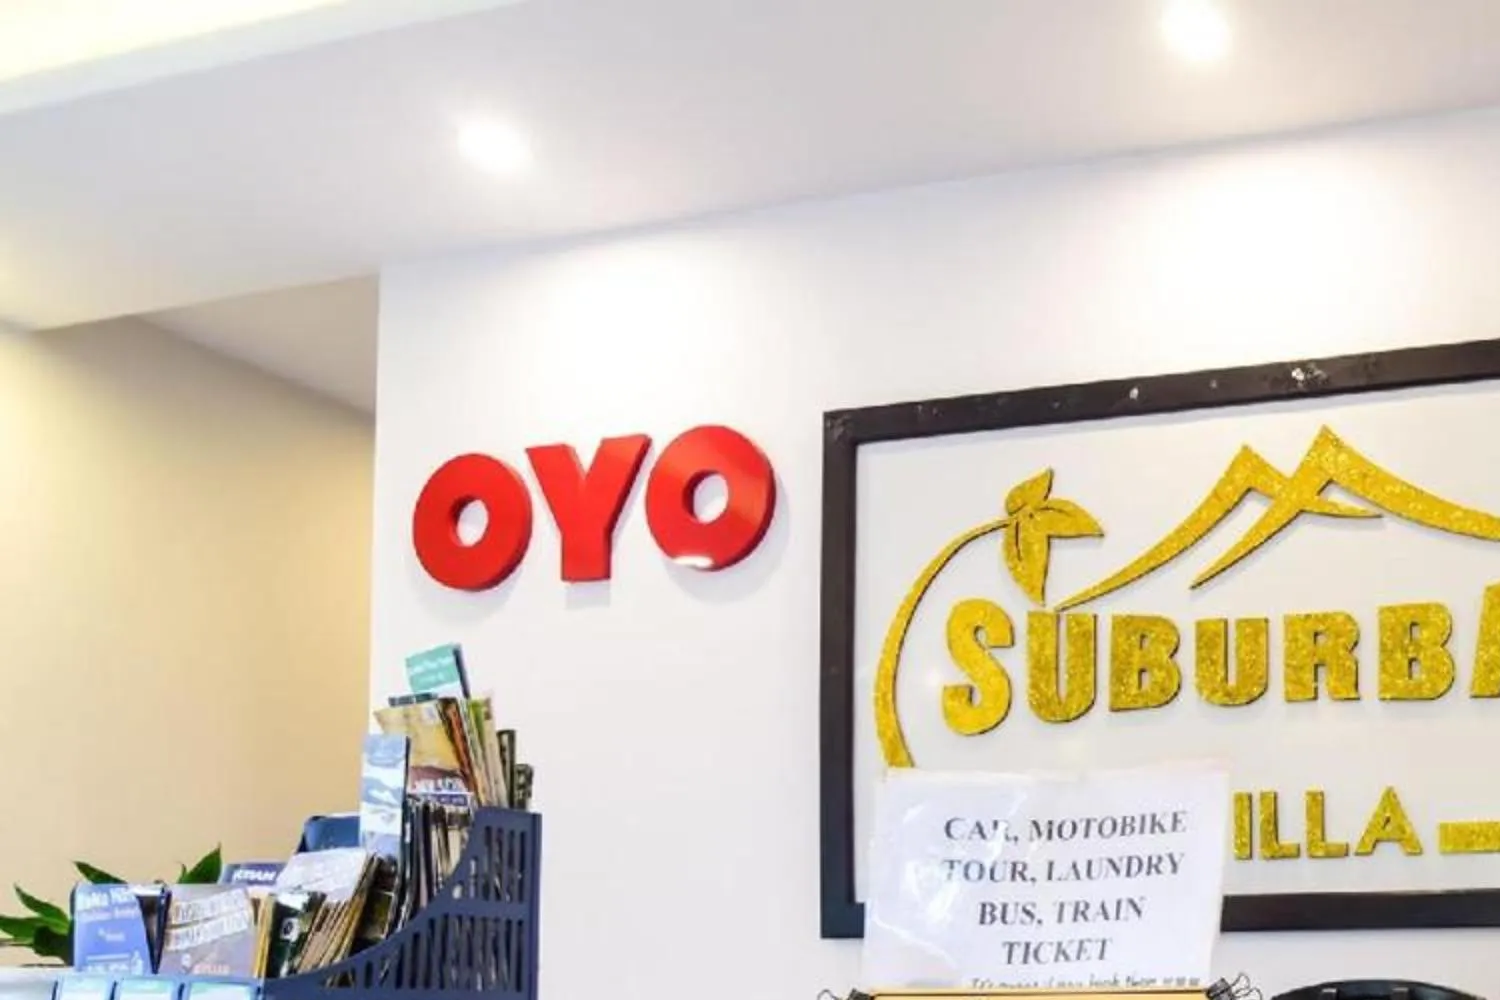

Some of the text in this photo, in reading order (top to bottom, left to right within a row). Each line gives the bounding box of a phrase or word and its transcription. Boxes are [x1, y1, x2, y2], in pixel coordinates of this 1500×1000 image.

[412, 424, 776, 592] OYO
[1029, 810, 1188, 842] MOTOBIKE
[1233, 786, 1423, 860] ILLA
[943, 851, 1185, 887] TOUR, LAUNDRY
[1054, 895, 1146, 924] TRAIN
[1003, 936, 1114, 966] TICKET
